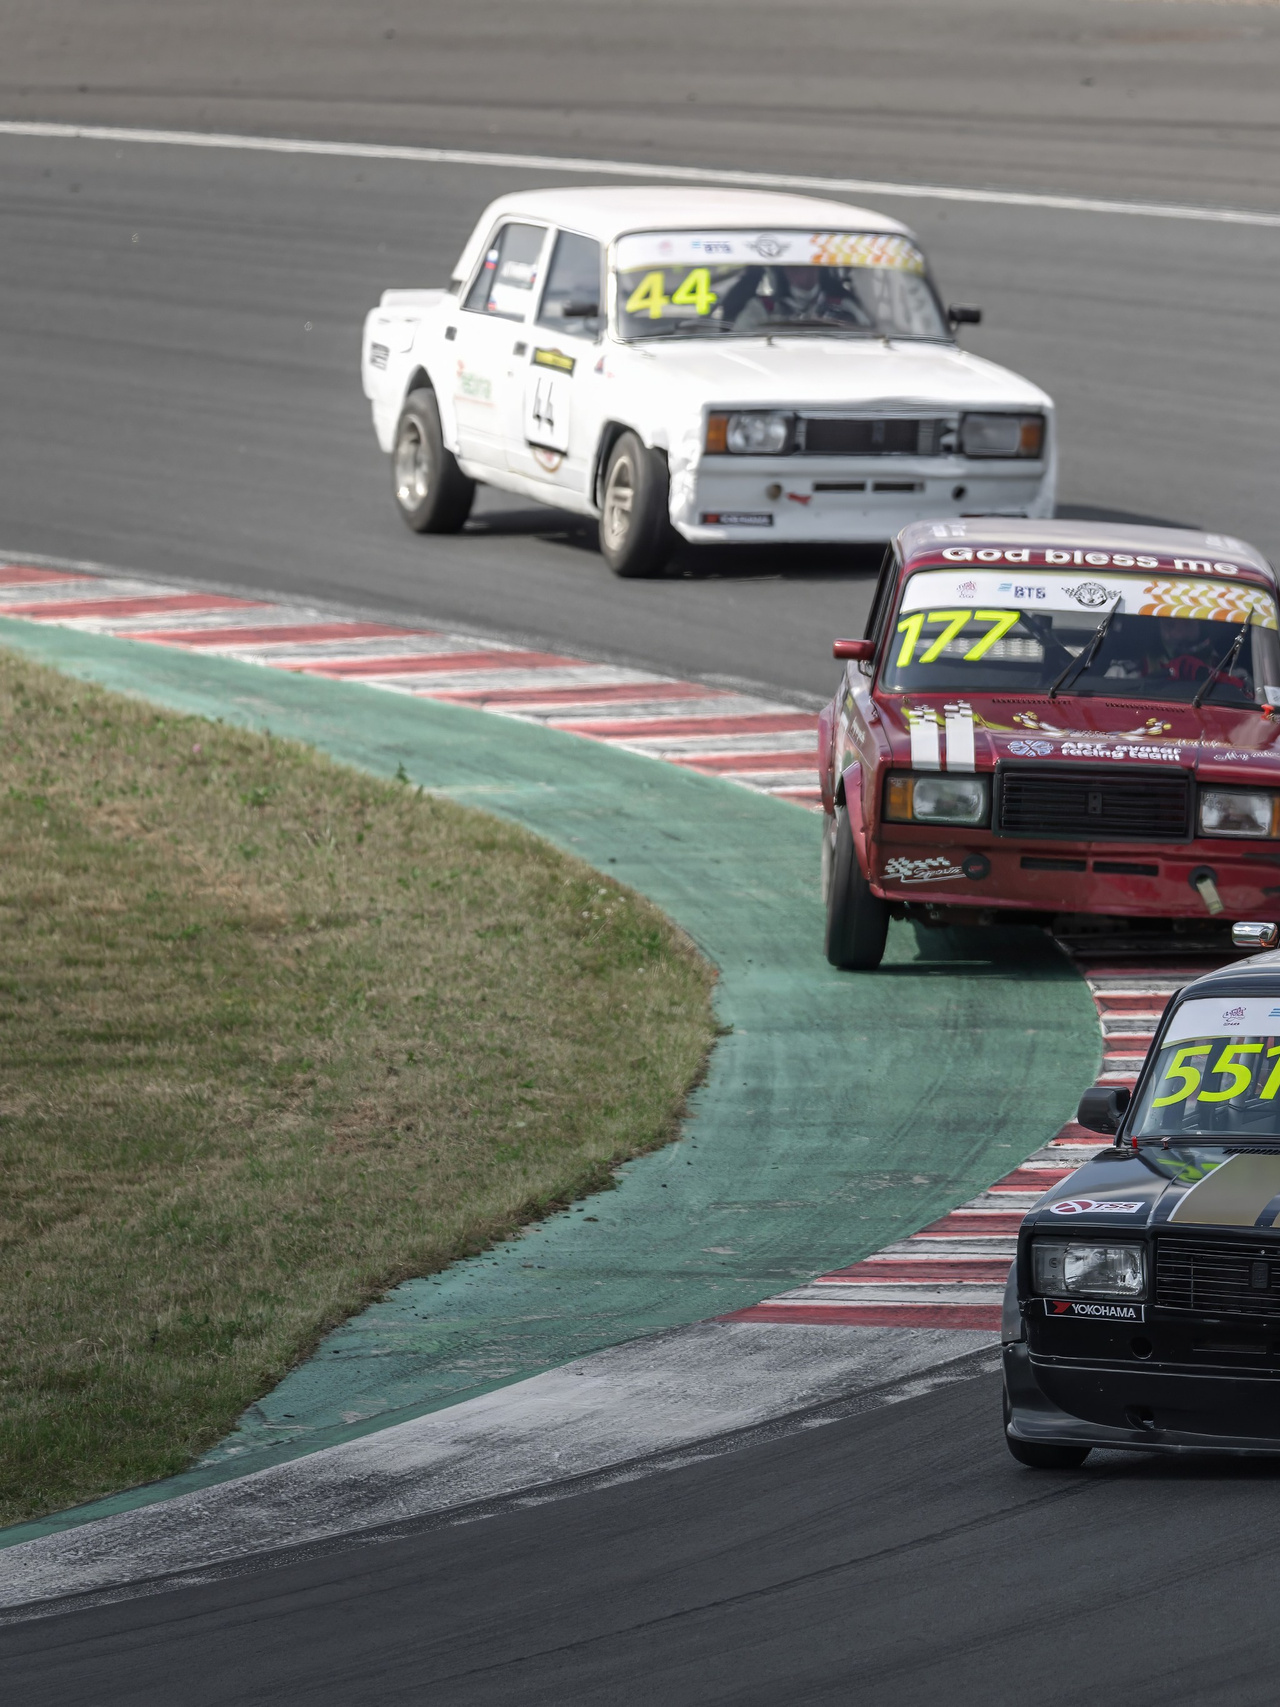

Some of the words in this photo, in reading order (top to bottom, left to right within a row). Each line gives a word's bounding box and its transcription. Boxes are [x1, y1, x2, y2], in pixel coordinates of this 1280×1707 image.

[626, 268, 717, 319] 44
[942, 547, 1030, 562] God
[1045, 549, 1159, 569] bless
[1173, 557, 1239, 576] me
[1014, 586, 1046, 599] ВТБ
[896, 610, 1020, 668] 177
[1071, 1303, 1137, 1318] YOKOHAMA
